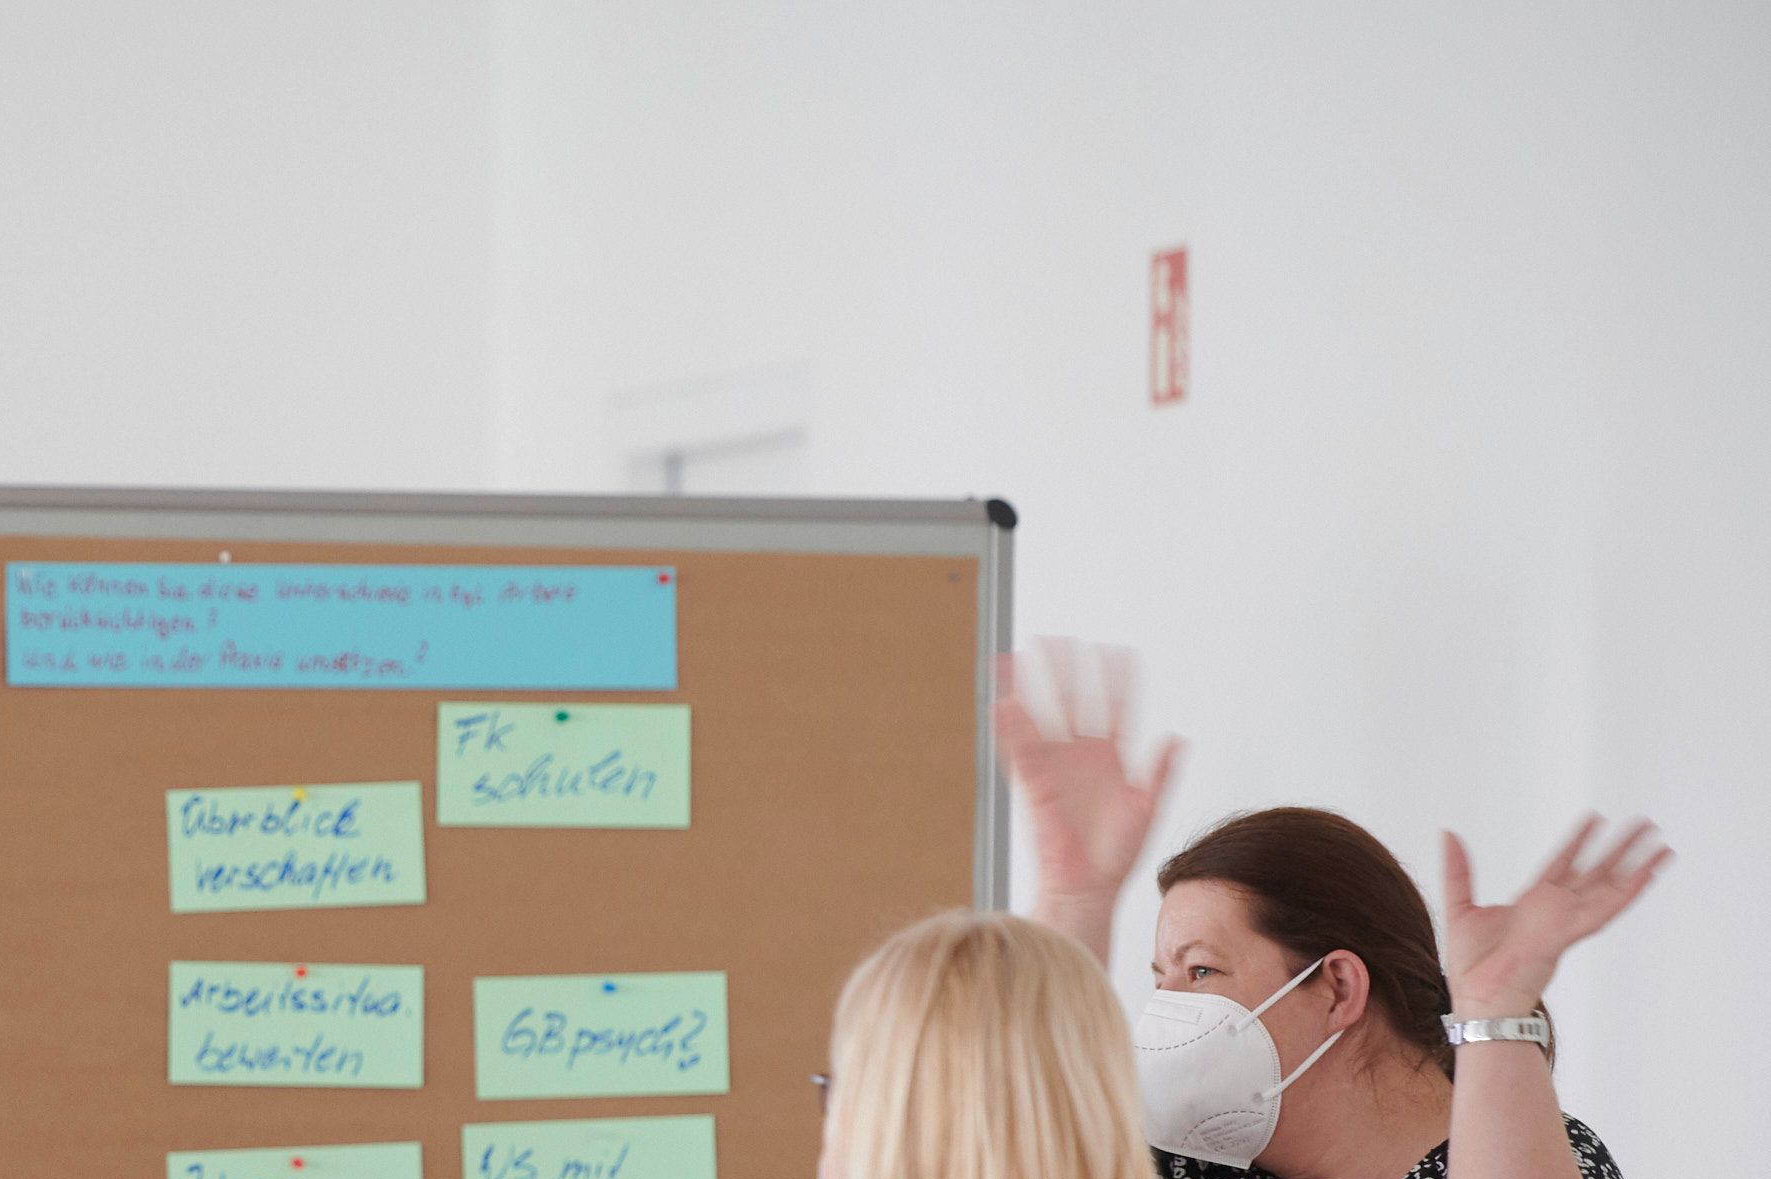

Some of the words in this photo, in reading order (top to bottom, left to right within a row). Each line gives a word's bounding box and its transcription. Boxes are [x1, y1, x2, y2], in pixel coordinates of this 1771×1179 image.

[471, 750, 658, 805] schulen
[181, 795, 362, 838] Überblick
[196, 850, 395, 902] verschaffen
[196, 1031, 364, 1076] bewerten
